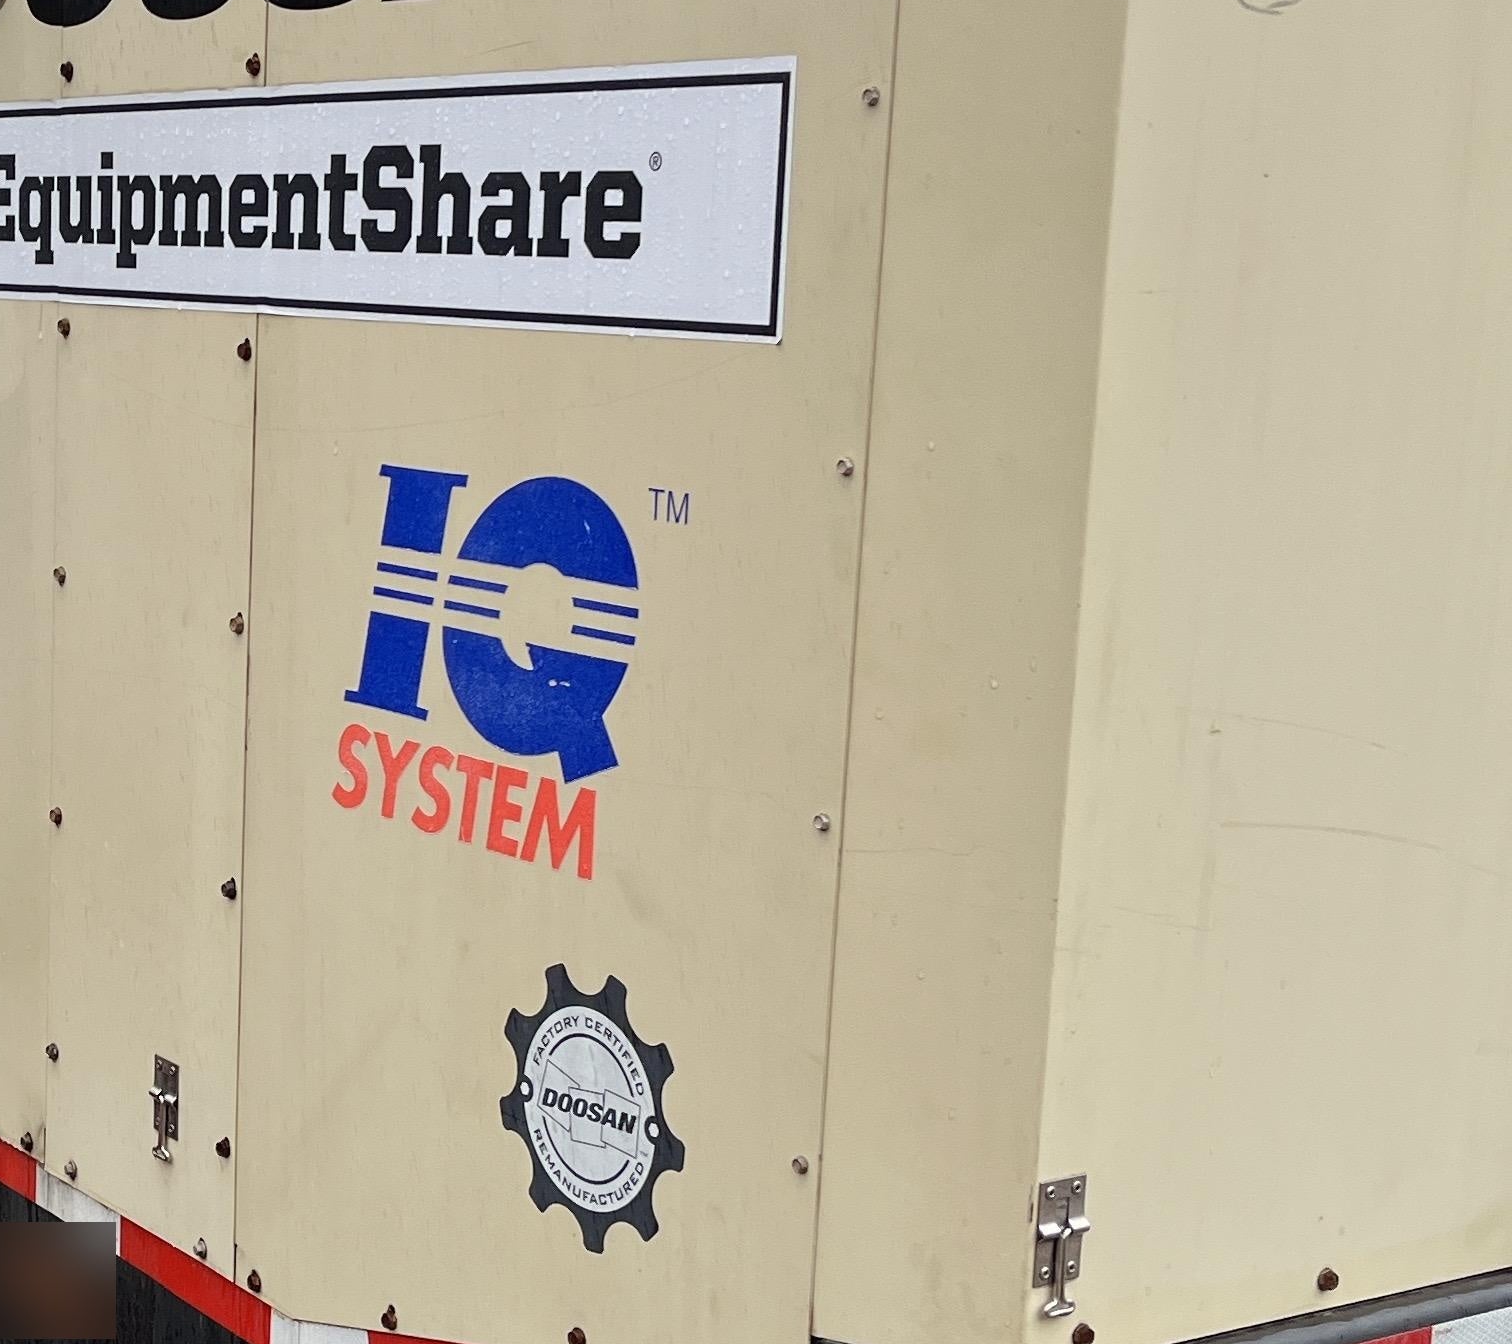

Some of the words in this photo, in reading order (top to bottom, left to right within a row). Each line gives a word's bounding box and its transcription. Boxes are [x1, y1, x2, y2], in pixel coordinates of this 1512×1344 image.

[344, 463, 640, 783] IQ
[332, 724, 597, 880] SYSTEM
[532, 1015, 580, 1066] FACTORY
[585, 1016, 644, 1096] CERTIFIED
[542, 1087, 637, 1134] DOOSAN
[533, 1128, 645, 1206] REMANUFACTURED
